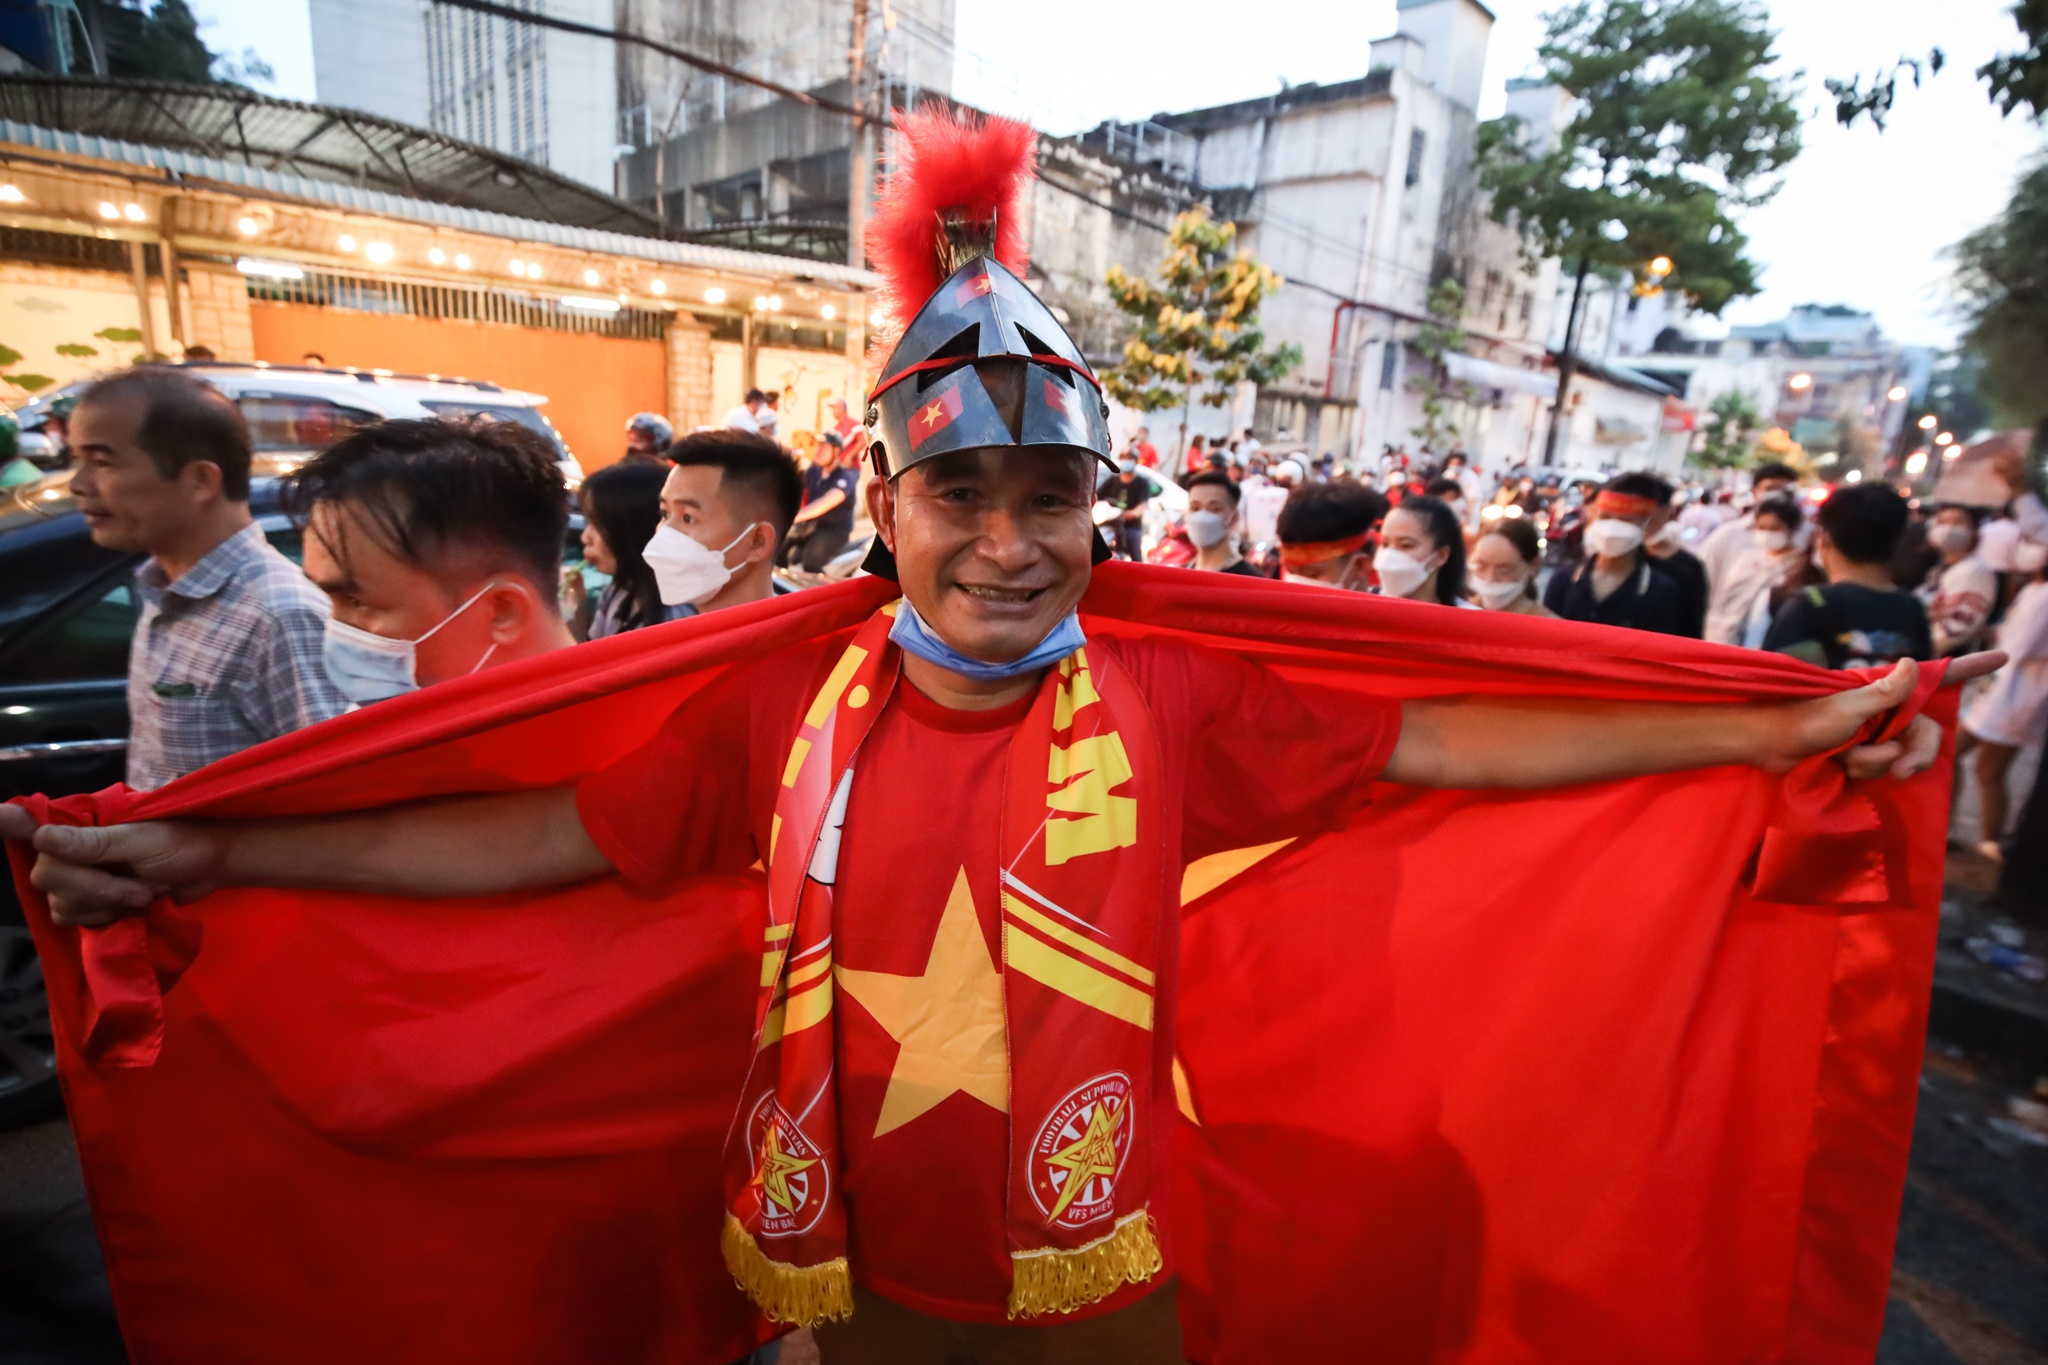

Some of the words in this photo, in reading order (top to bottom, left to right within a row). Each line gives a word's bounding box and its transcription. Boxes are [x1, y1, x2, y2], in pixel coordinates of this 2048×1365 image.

[1039, 1100, 1080, 1154] FOOTBALL
[1068, 1208, 1088, 1220] VFS
[762, 1217, 779, 1230] IEN
